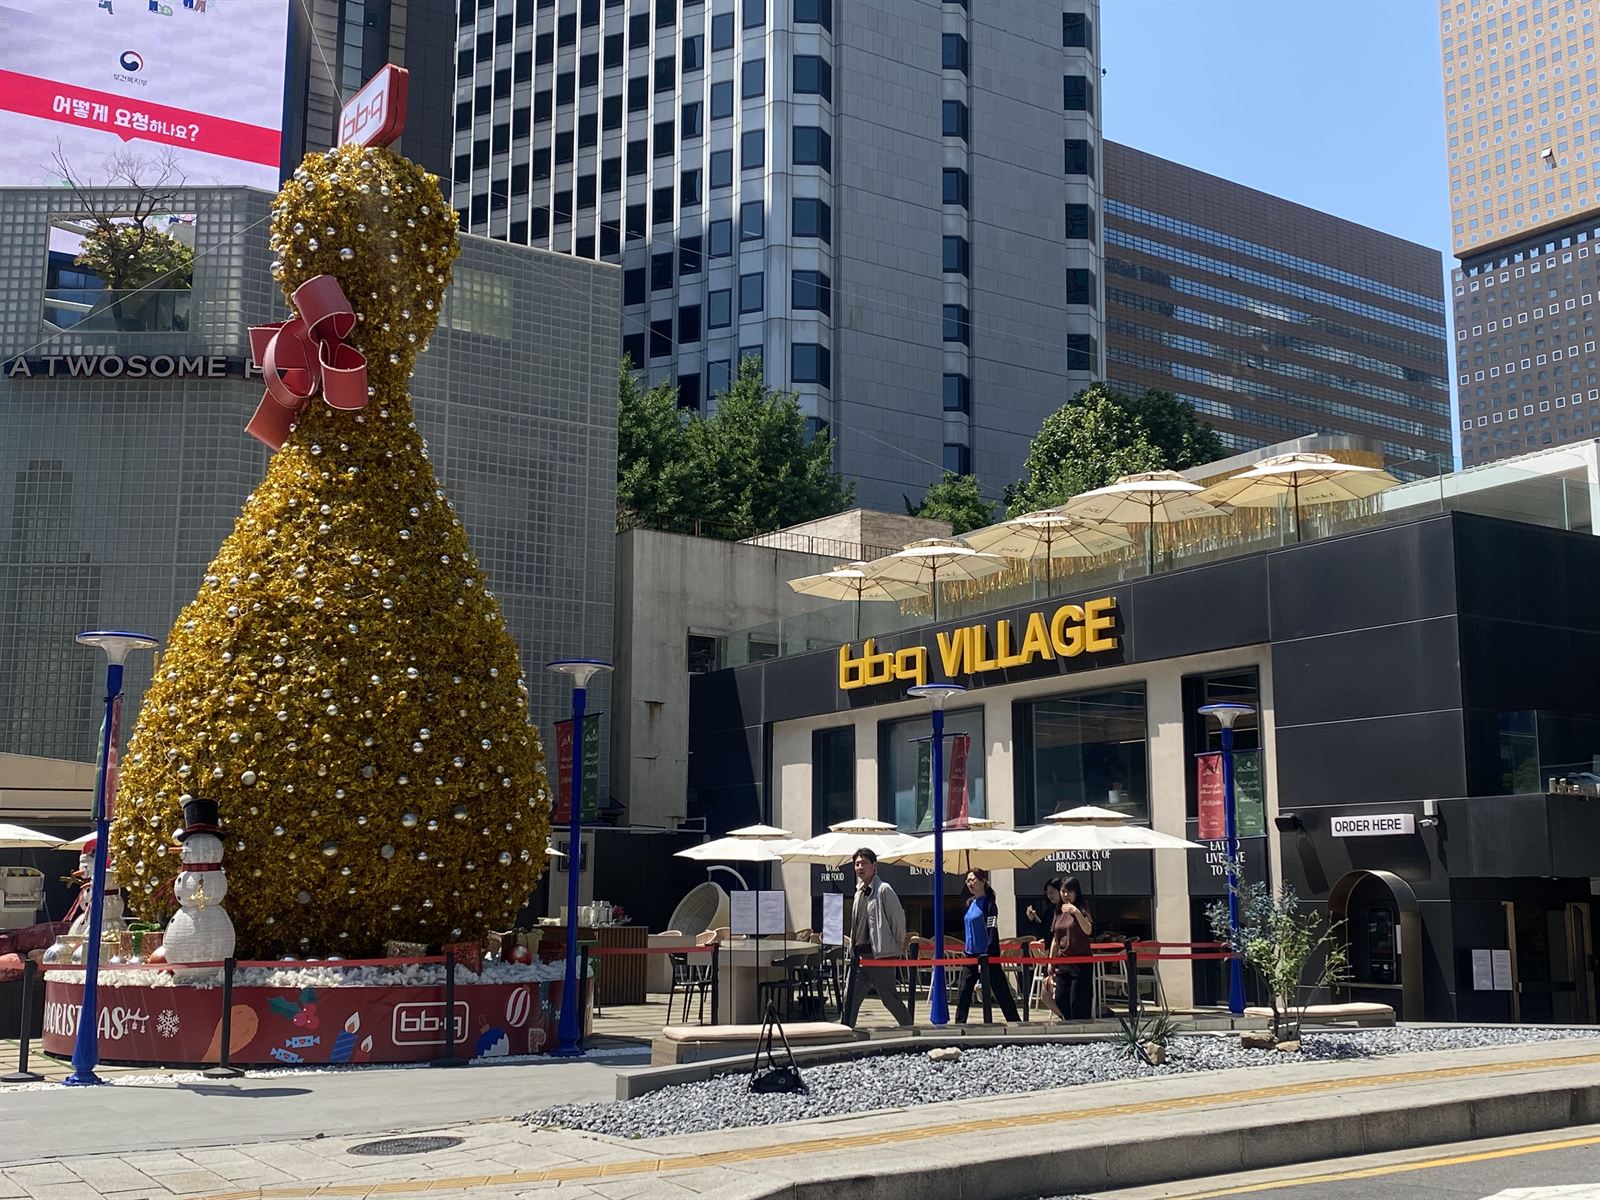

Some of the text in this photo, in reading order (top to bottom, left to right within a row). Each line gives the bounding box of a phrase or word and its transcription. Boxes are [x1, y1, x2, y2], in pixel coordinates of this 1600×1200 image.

[52, 95, 200, 142] 어떻게 요청하나요?
[9, 356, 33, 377] A
[41, 355, 227, 378] TWOSOME
[936, 596, 1117, 677] VILLAGE
[1334, 818, 1402, 833] ORDER HERE
